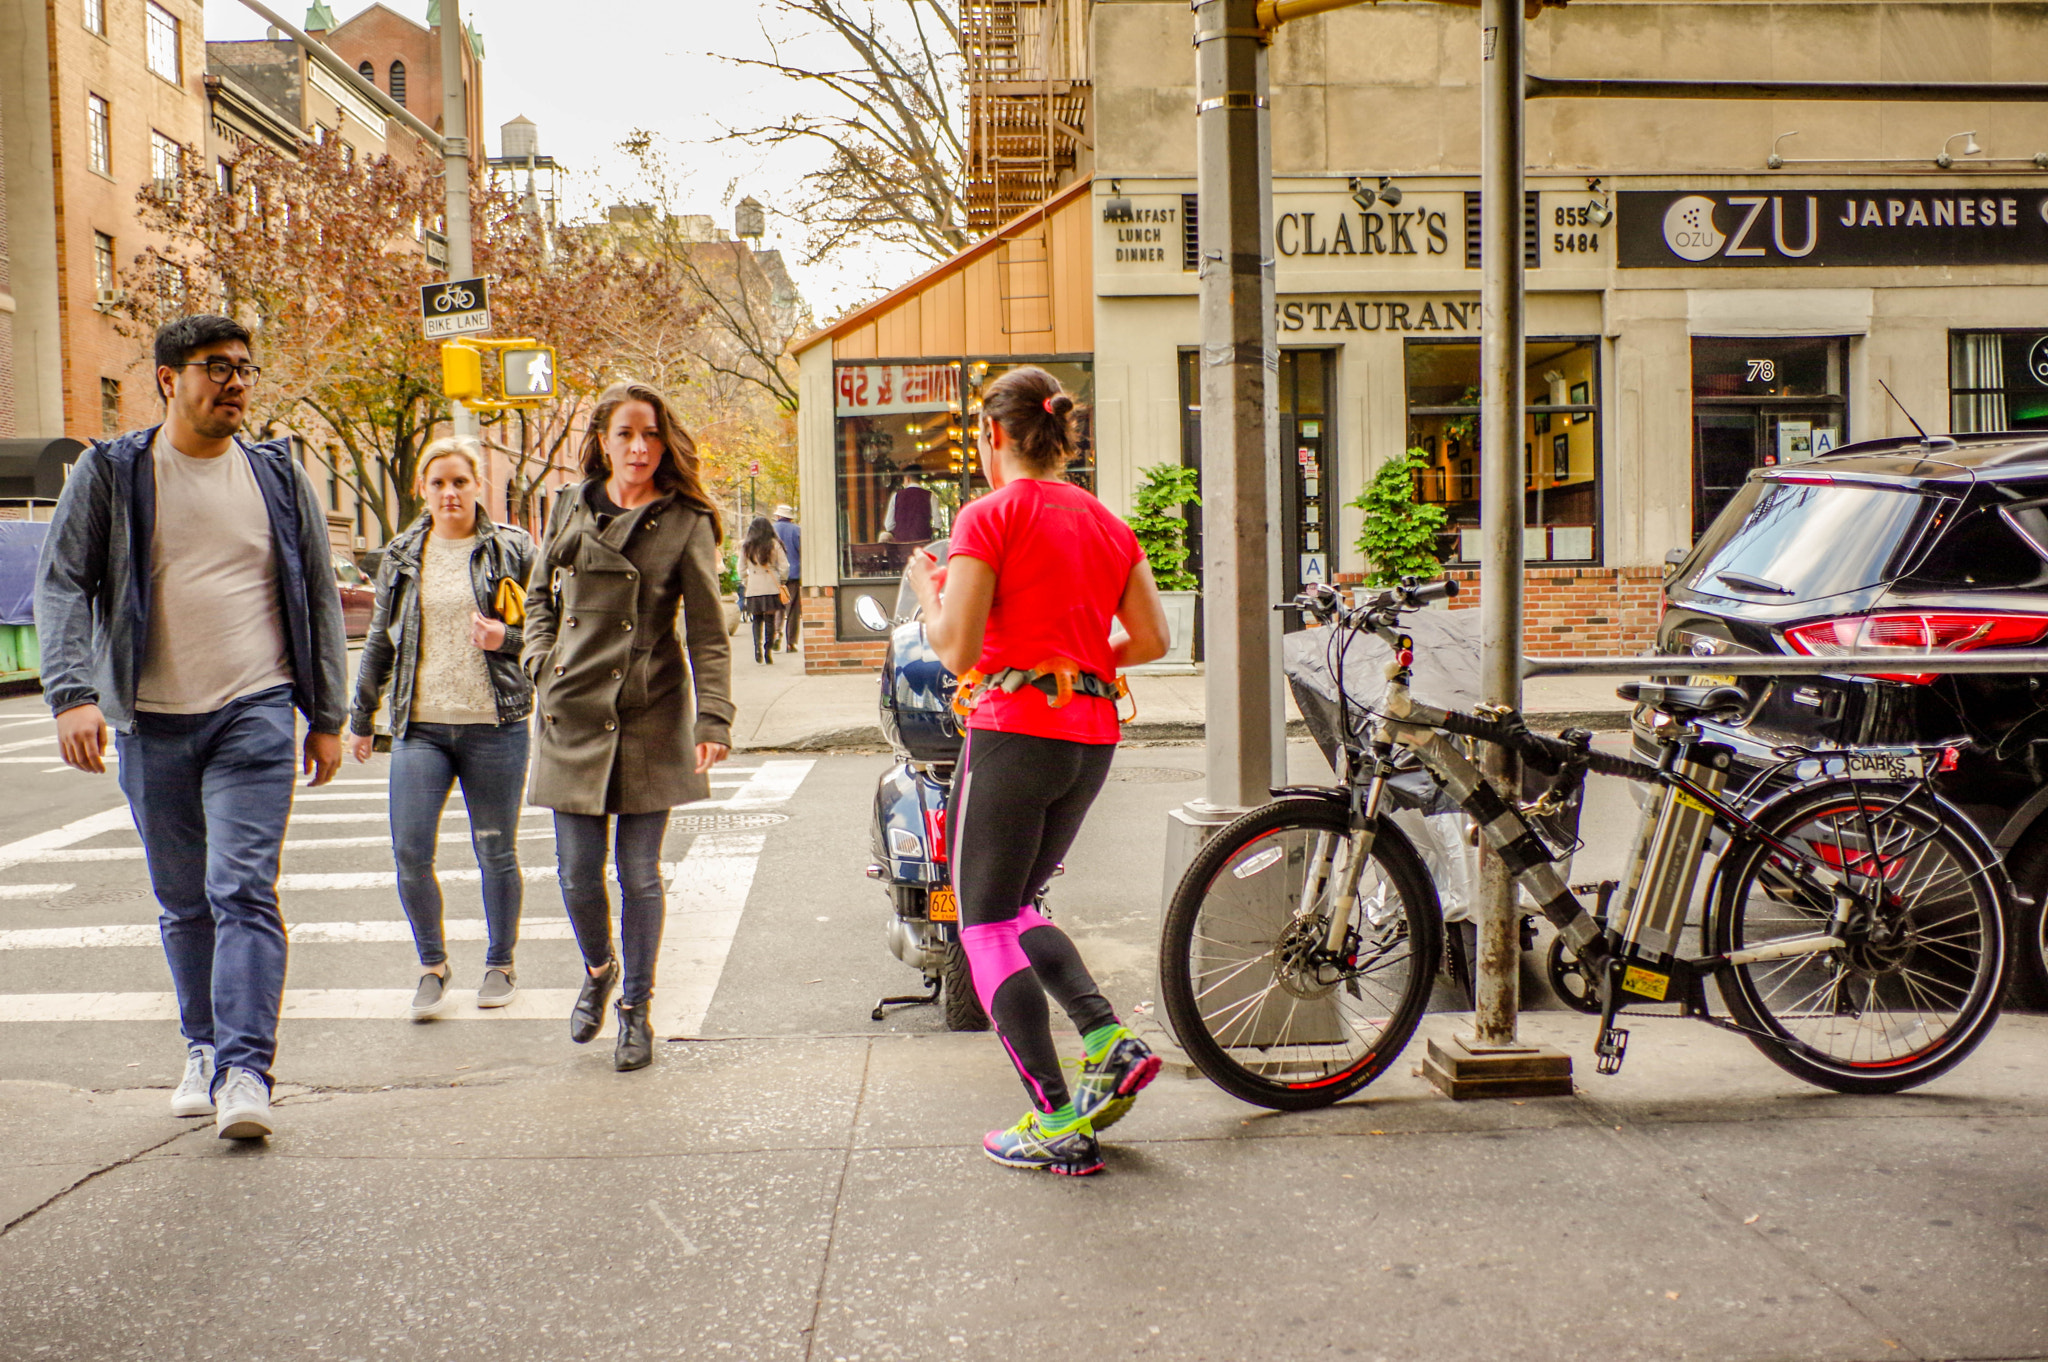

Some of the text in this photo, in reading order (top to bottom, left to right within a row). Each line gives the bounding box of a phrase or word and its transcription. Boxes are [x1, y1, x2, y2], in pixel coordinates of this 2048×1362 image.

[1555, 206, 1588, 227] 855
[1840, 200, 2018, 227] JAPANESE
[1118, 229, 1161, 242] LUNCH
[1276, 206, 1448, 256] CLARK'S
[1675, 232, 1713, 247] OZU
[1554, 233, 1599, 253] 5484
[1116, 248, 1164, 262] DINNER
[428, 313, 486, 333] BIKE LANE
[1746, 359, 1775, 382] 78
[1817, 433, 1832, 451] A
[1306, 557, 1321, 576] A
